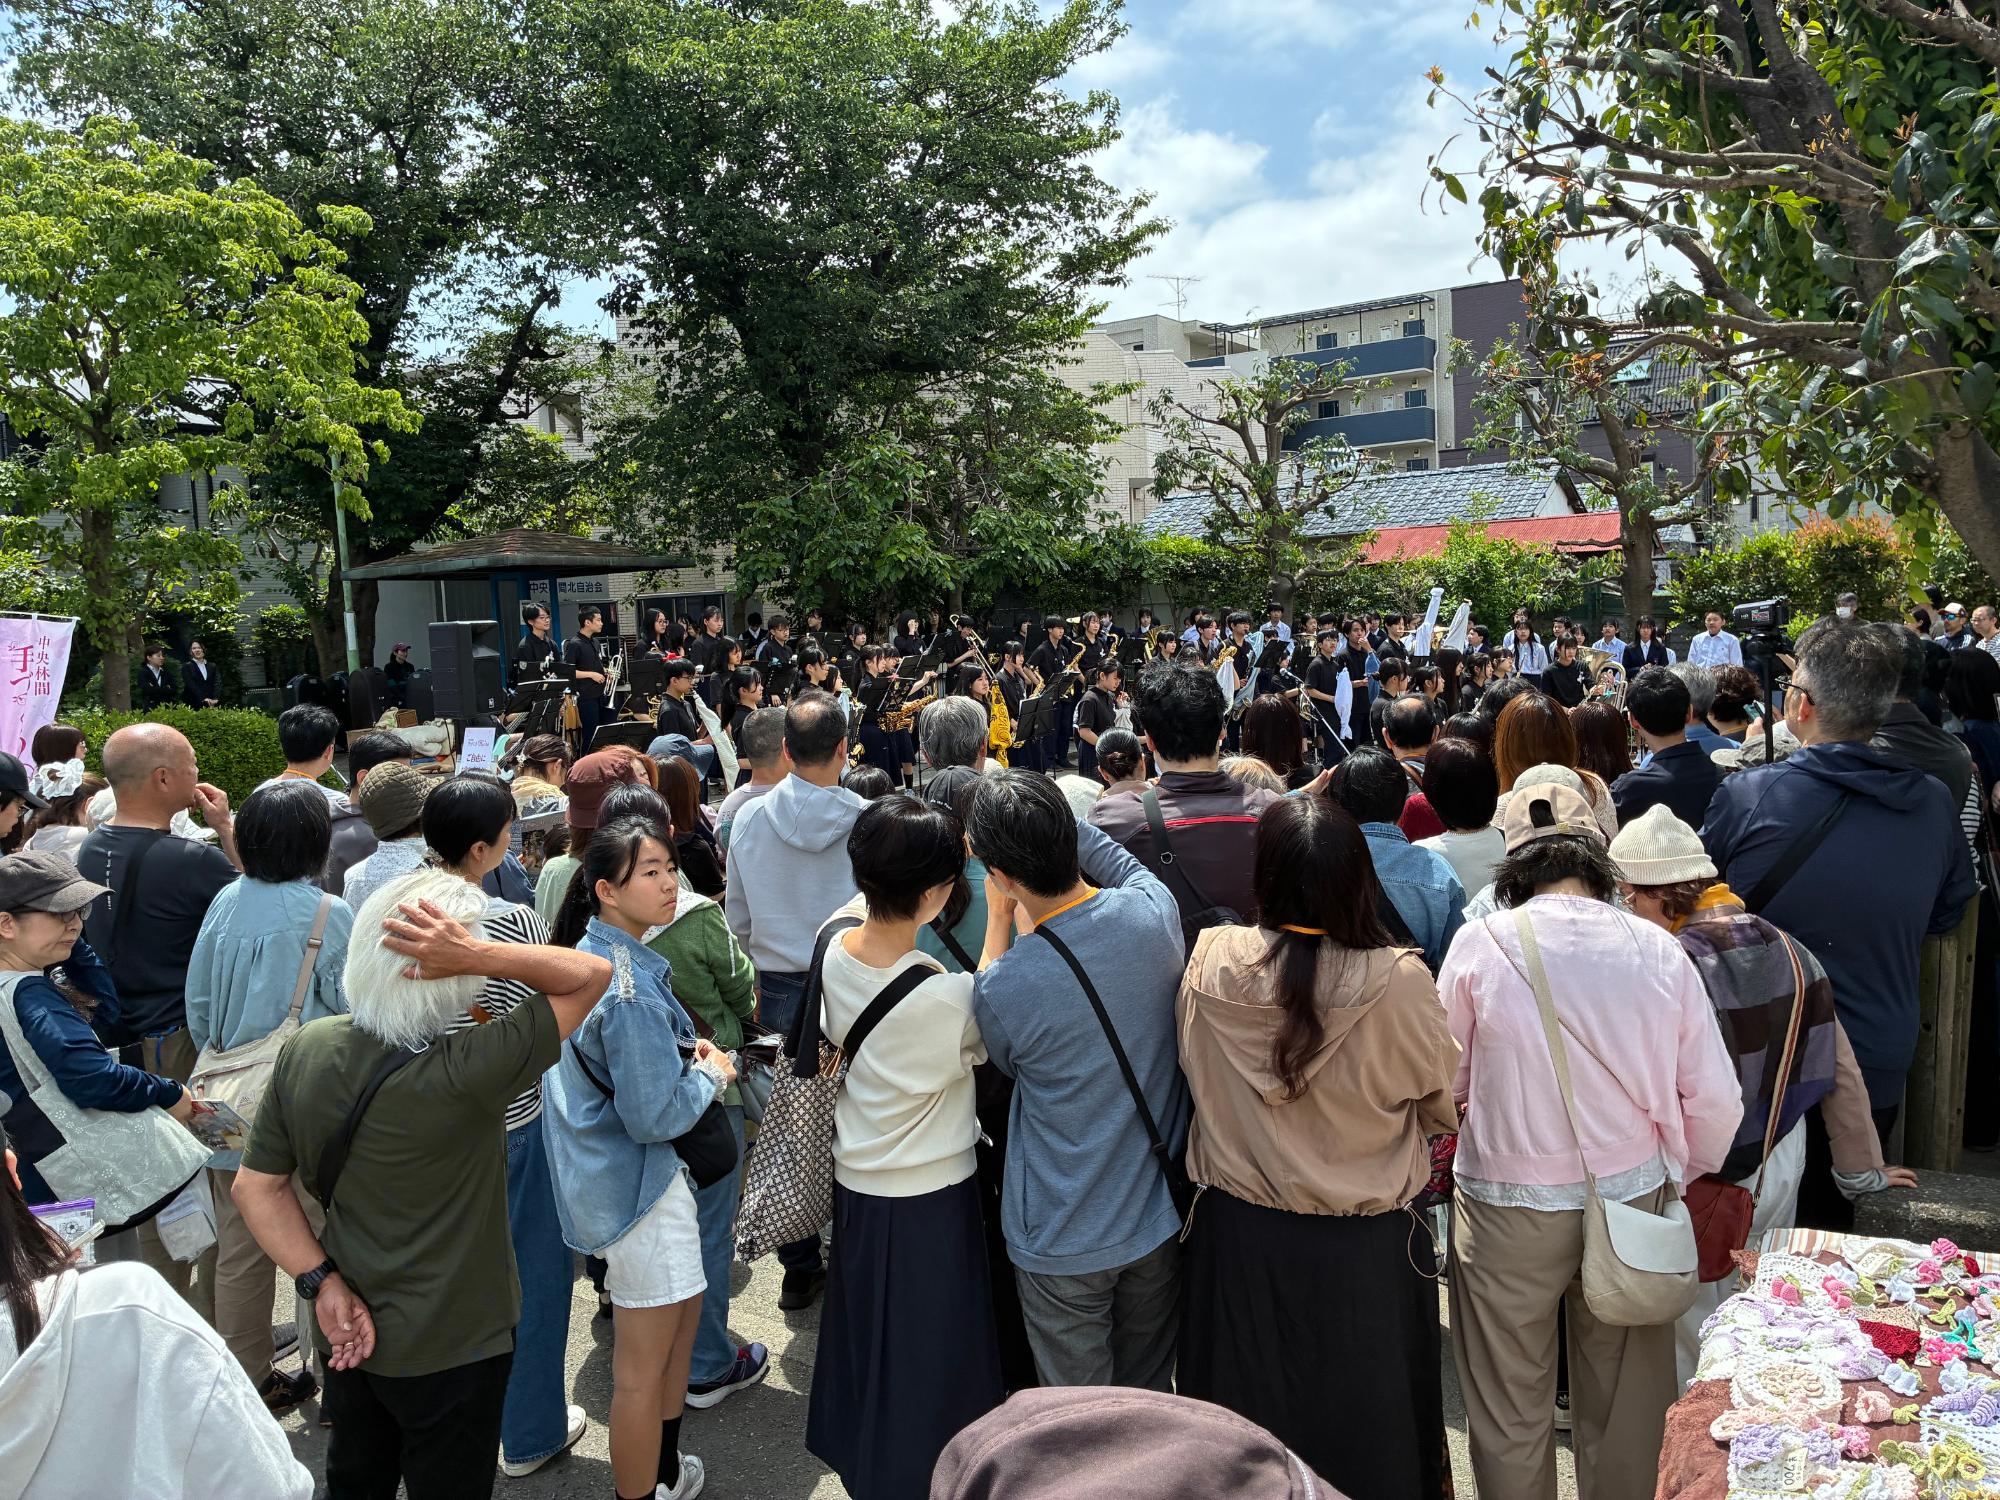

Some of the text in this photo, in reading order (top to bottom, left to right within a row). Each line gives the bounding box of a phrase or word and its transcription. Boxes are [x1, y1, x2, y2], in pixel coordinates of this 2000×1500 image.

[530, 582, 602, 593] 中央間北自治会
[34, 635, 50, 696] 中央林間
[1784, 1456, 1797, 1485] ¥700
